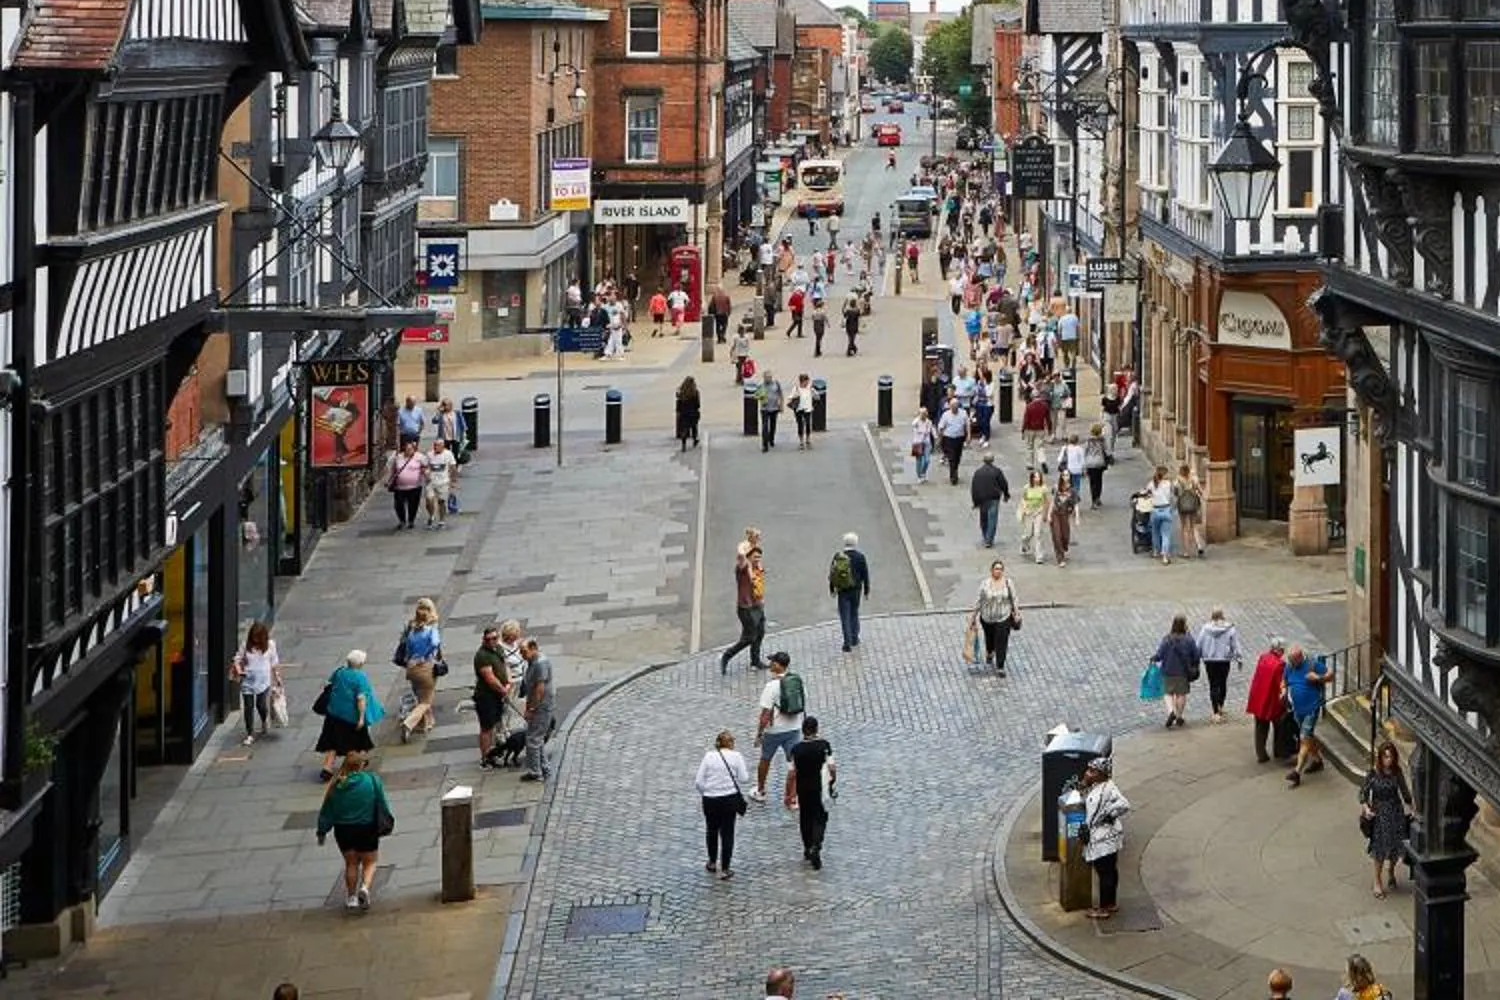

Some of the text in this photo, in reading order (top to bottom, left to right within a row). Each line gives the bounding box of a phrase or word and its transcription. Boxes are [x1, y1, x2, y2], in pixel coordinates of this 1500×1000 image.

[554, 187, 568, 196] TO
[601, 205, 680, 217] RIVER ISLAND
[1089, 263, 1117, 271] LUSH
